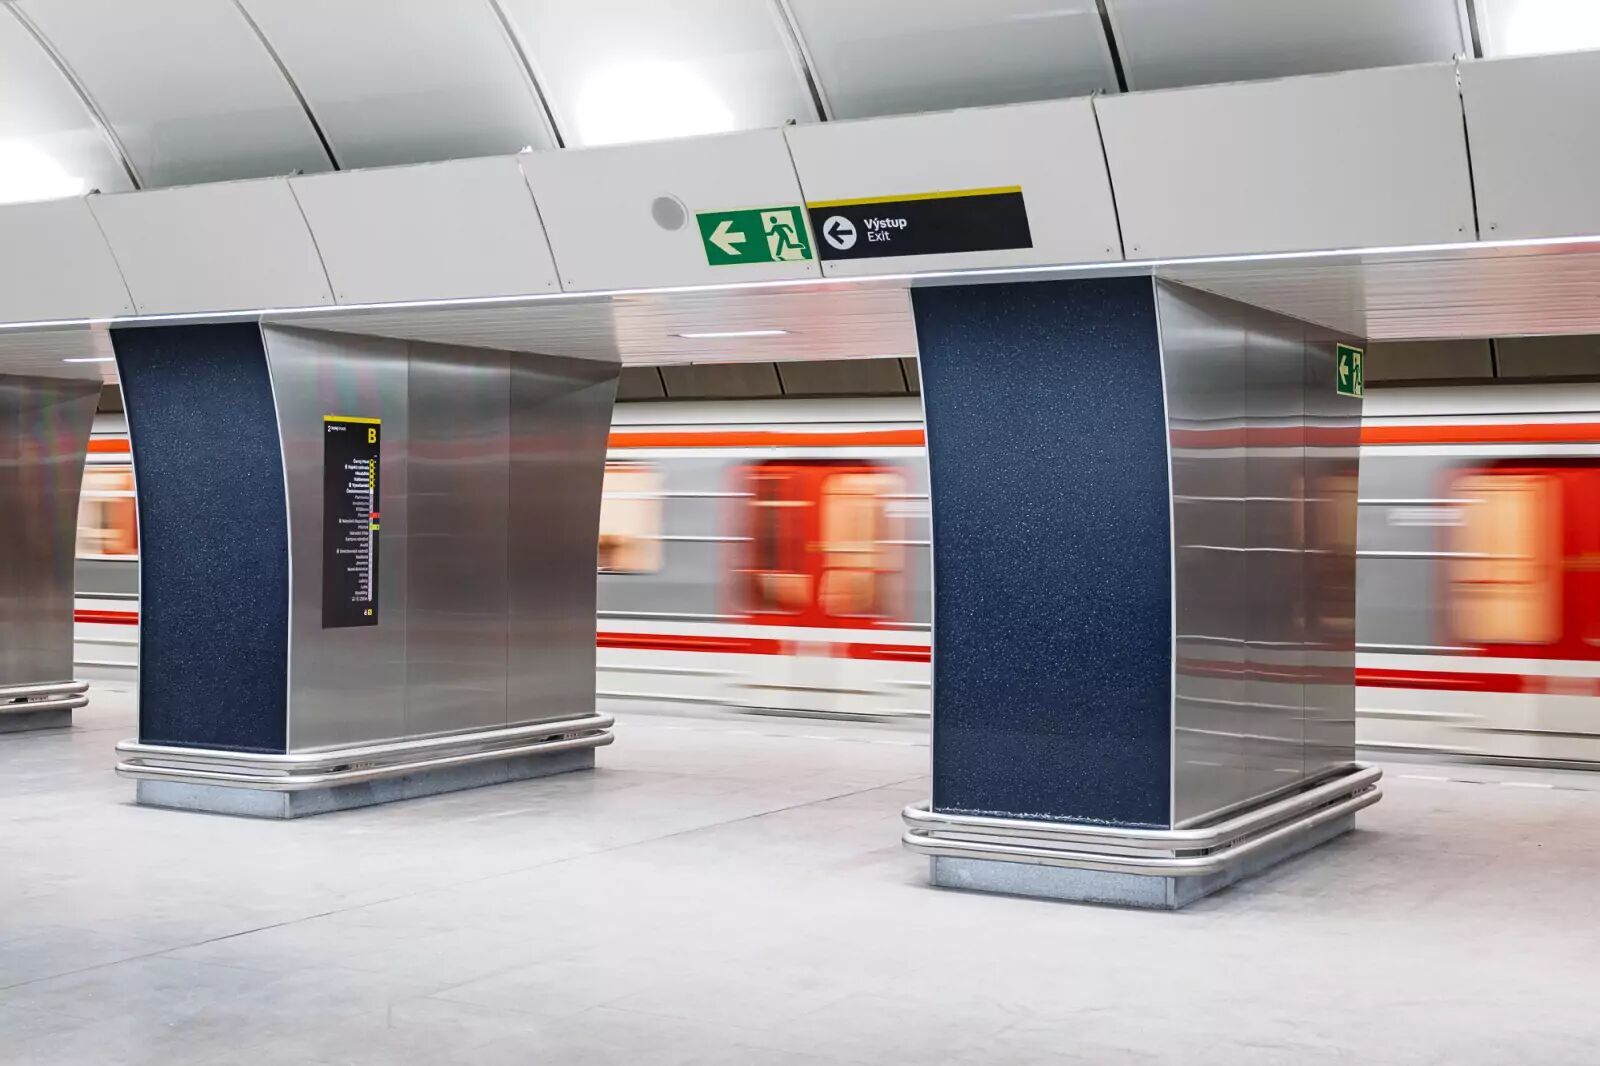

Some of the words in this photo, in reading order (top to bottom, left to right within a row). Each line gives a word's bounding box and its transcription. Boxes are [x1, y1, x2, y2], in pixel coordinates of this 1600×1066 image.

[863, 218, 907, 231] Výstup
[867, 231, 891, 242] Exit
[368, 428, 377, 443] B
